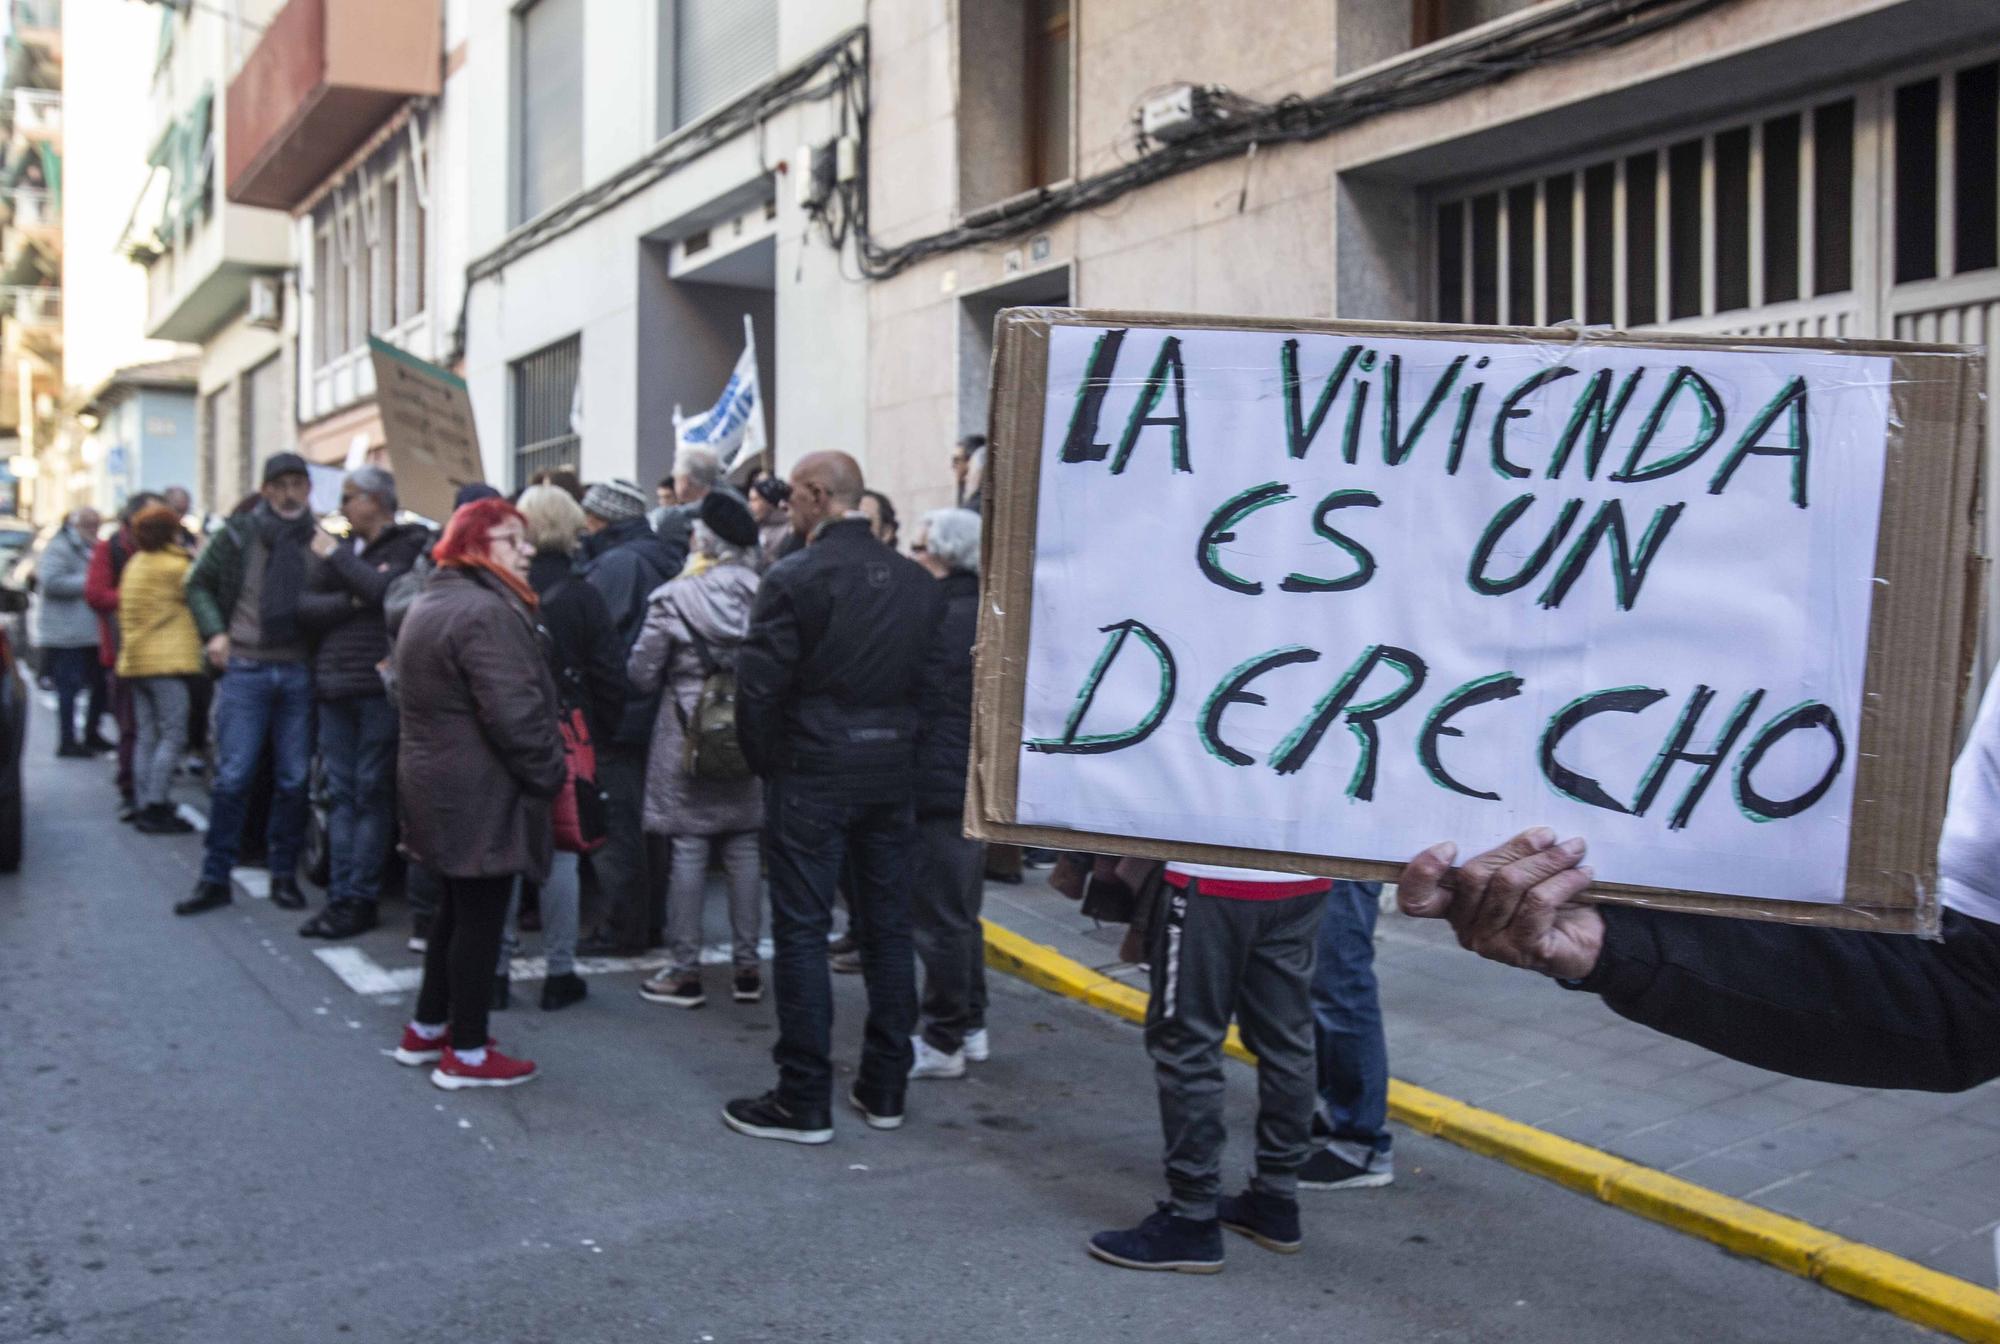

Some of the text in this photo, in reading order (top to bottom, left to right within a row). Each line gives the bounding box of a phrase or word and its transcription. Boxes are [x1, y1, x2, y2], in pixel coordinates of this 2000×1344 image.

[1060, 328, 1193, 475] LA
[1196, 480, 1687, 611] ES UN
[1022, 618, 1847, 832] DERECHO
